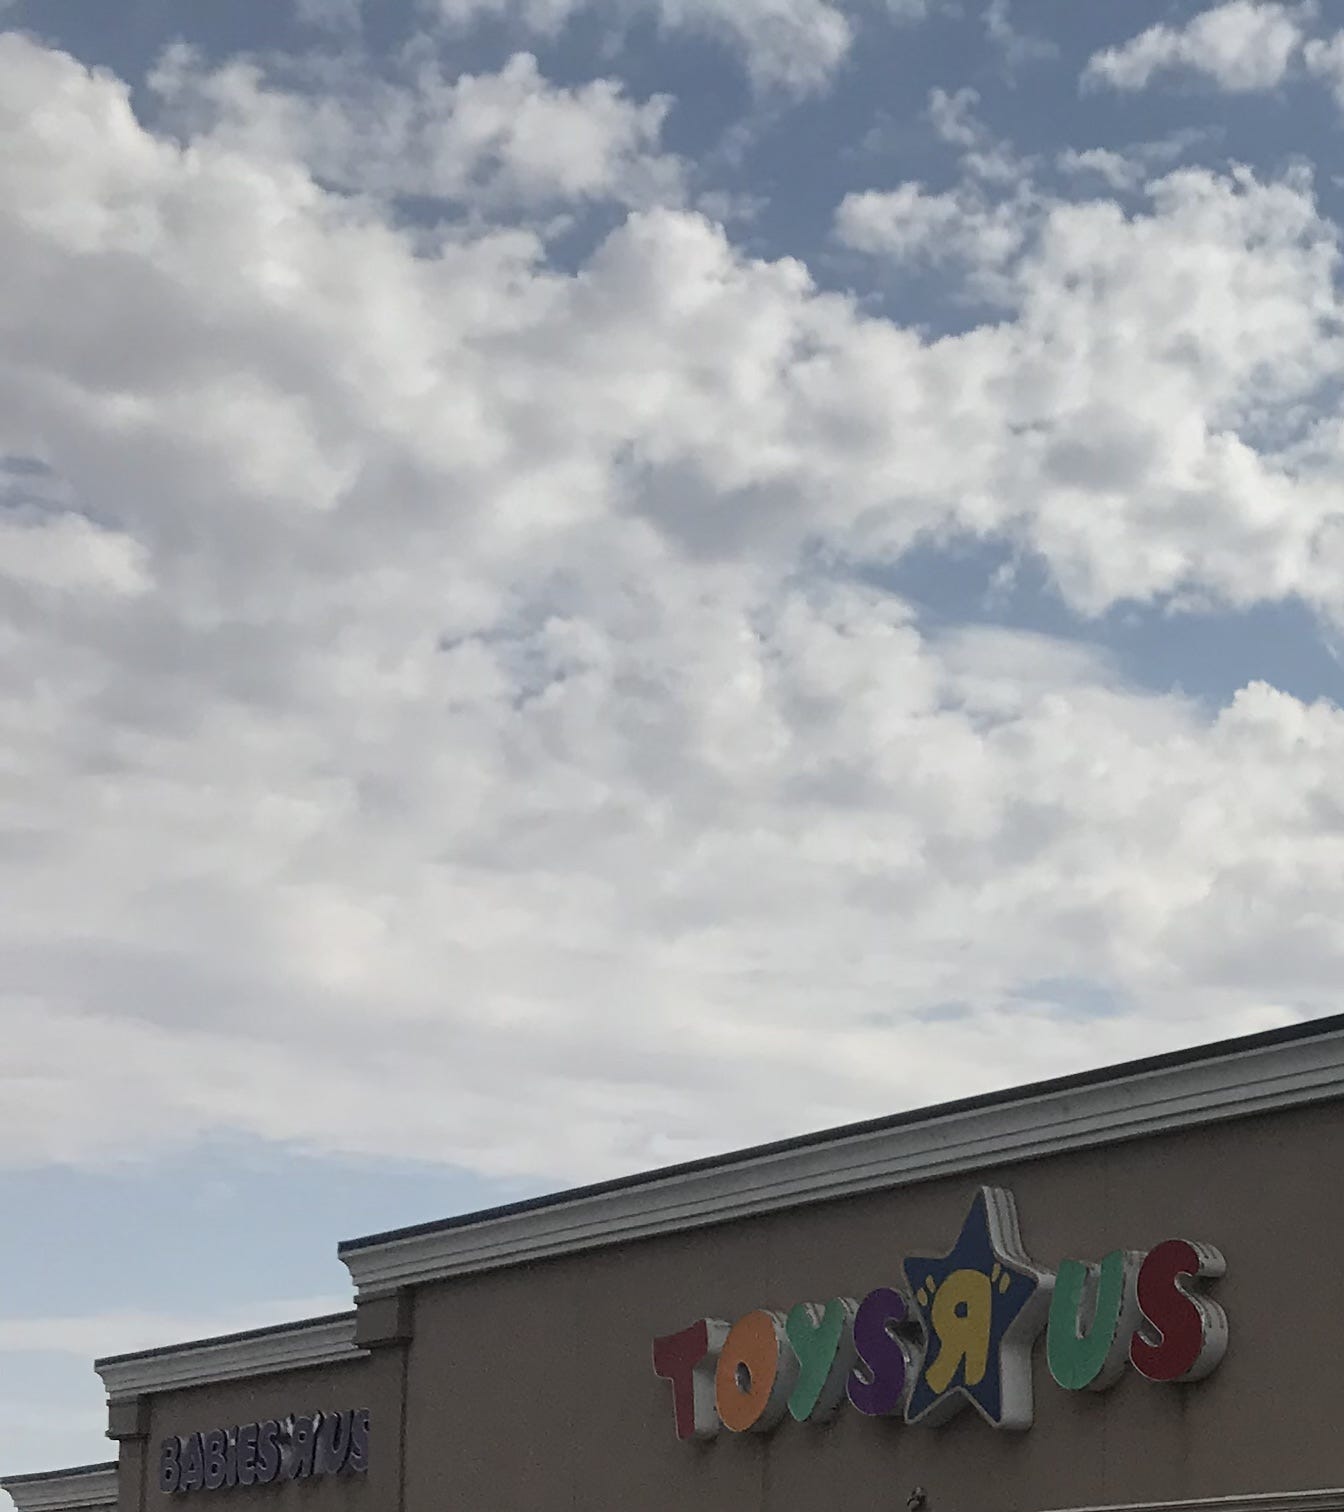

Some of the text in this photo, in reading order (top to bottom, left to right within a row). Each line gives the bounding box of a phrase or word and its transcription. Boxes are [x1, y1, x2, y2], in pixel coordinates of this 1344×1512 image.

[652, 1287, 908, 1441] TOYS
[1046, 1238, 1208, 1391] US
[323, 1407, 370, 1474] US
